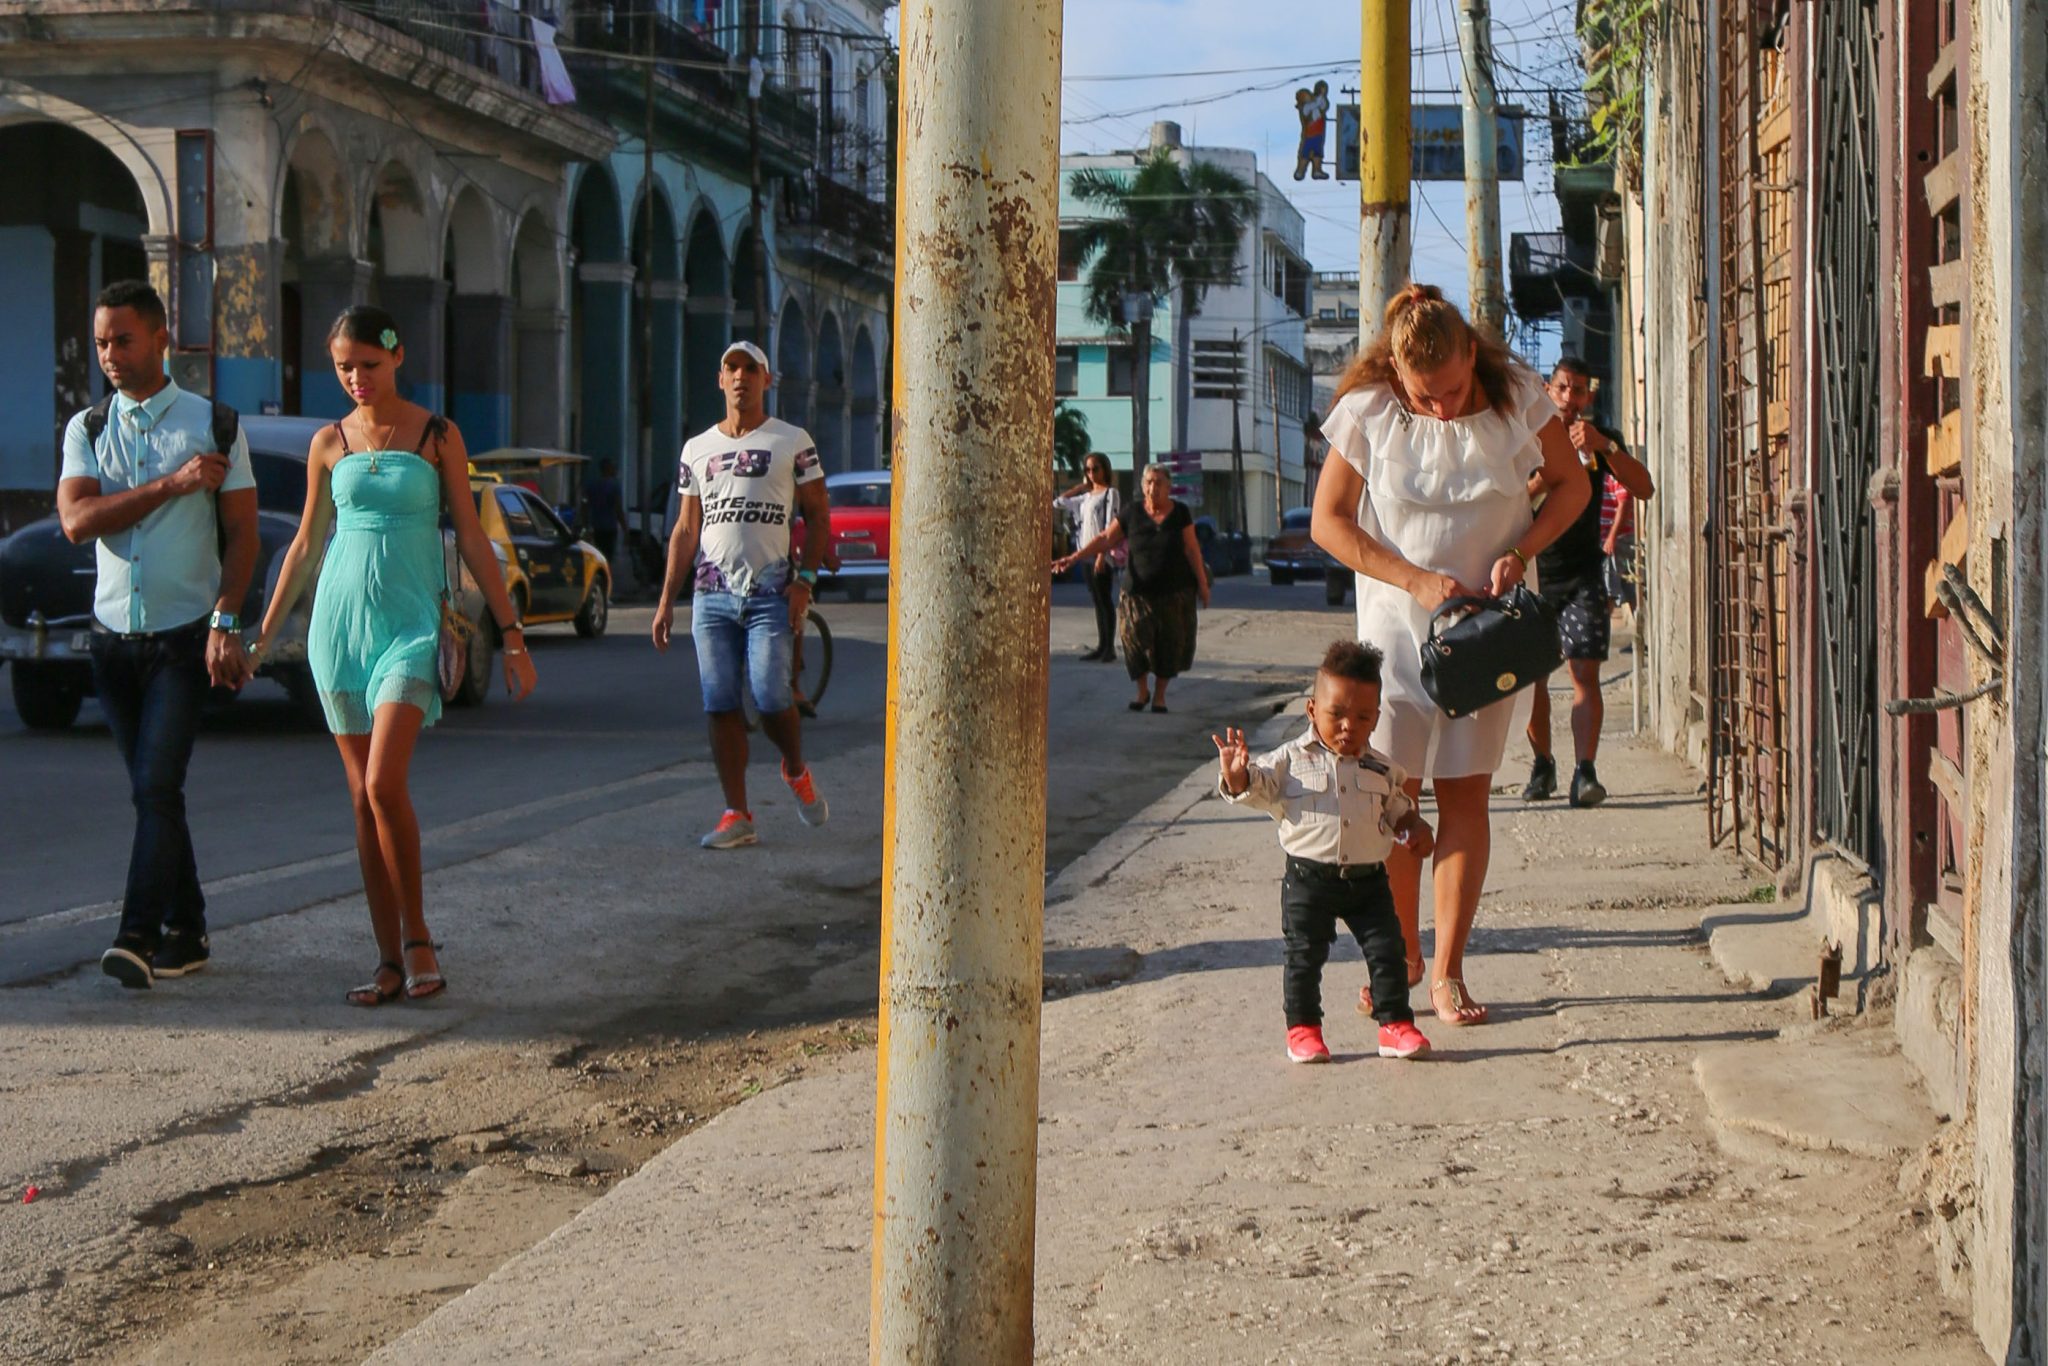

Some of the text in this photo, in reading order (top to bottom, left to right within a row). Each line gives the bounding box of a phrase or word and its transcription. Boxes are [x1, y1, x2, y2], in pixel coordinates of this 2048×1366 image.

[705, 449, 772, 483] F8
[705, 496, 785, 513] FATE OF THE
[704, 510, 786, 530] FURIOUS
